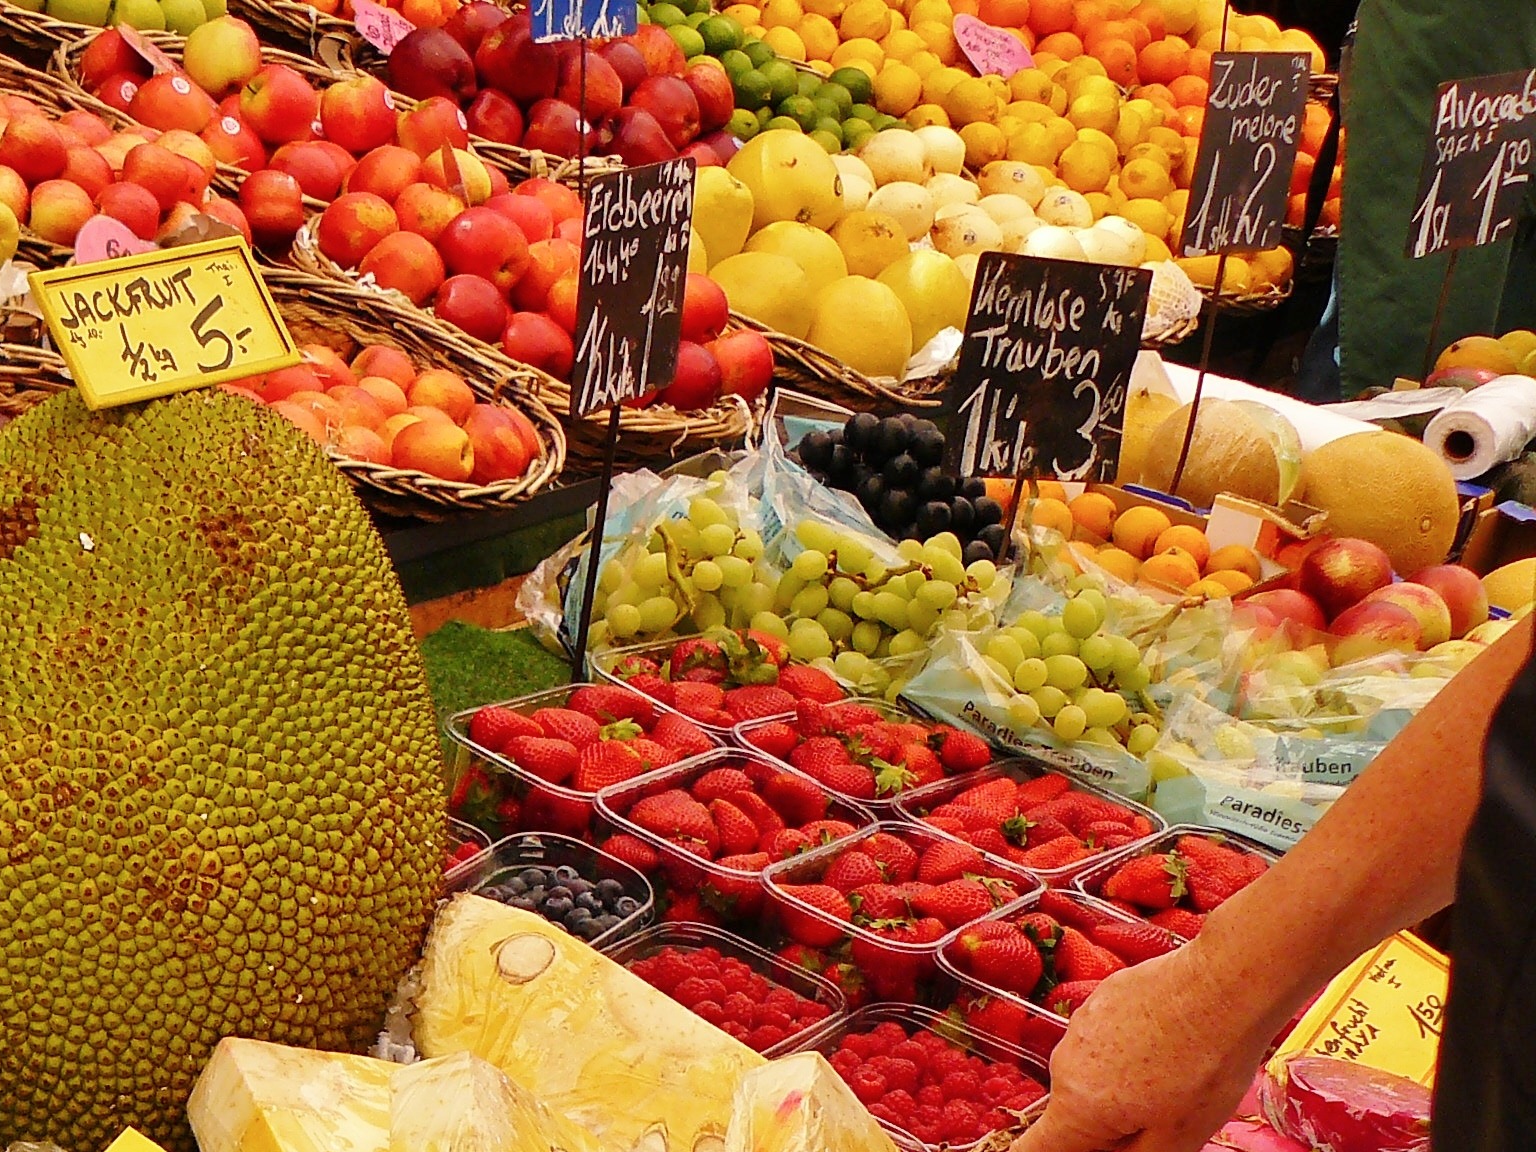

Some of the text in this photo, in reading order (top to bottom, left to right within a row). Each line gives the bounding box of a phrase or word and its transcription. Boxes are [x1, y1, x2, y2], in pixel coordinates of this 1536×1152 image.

[1230, 112, 1297, 145] melone
[59, 267, 197, 330] JACKFRUIT
[973, 260, 1085, 333] Kernlose
[970, 324, 1101, 380] Trauben
